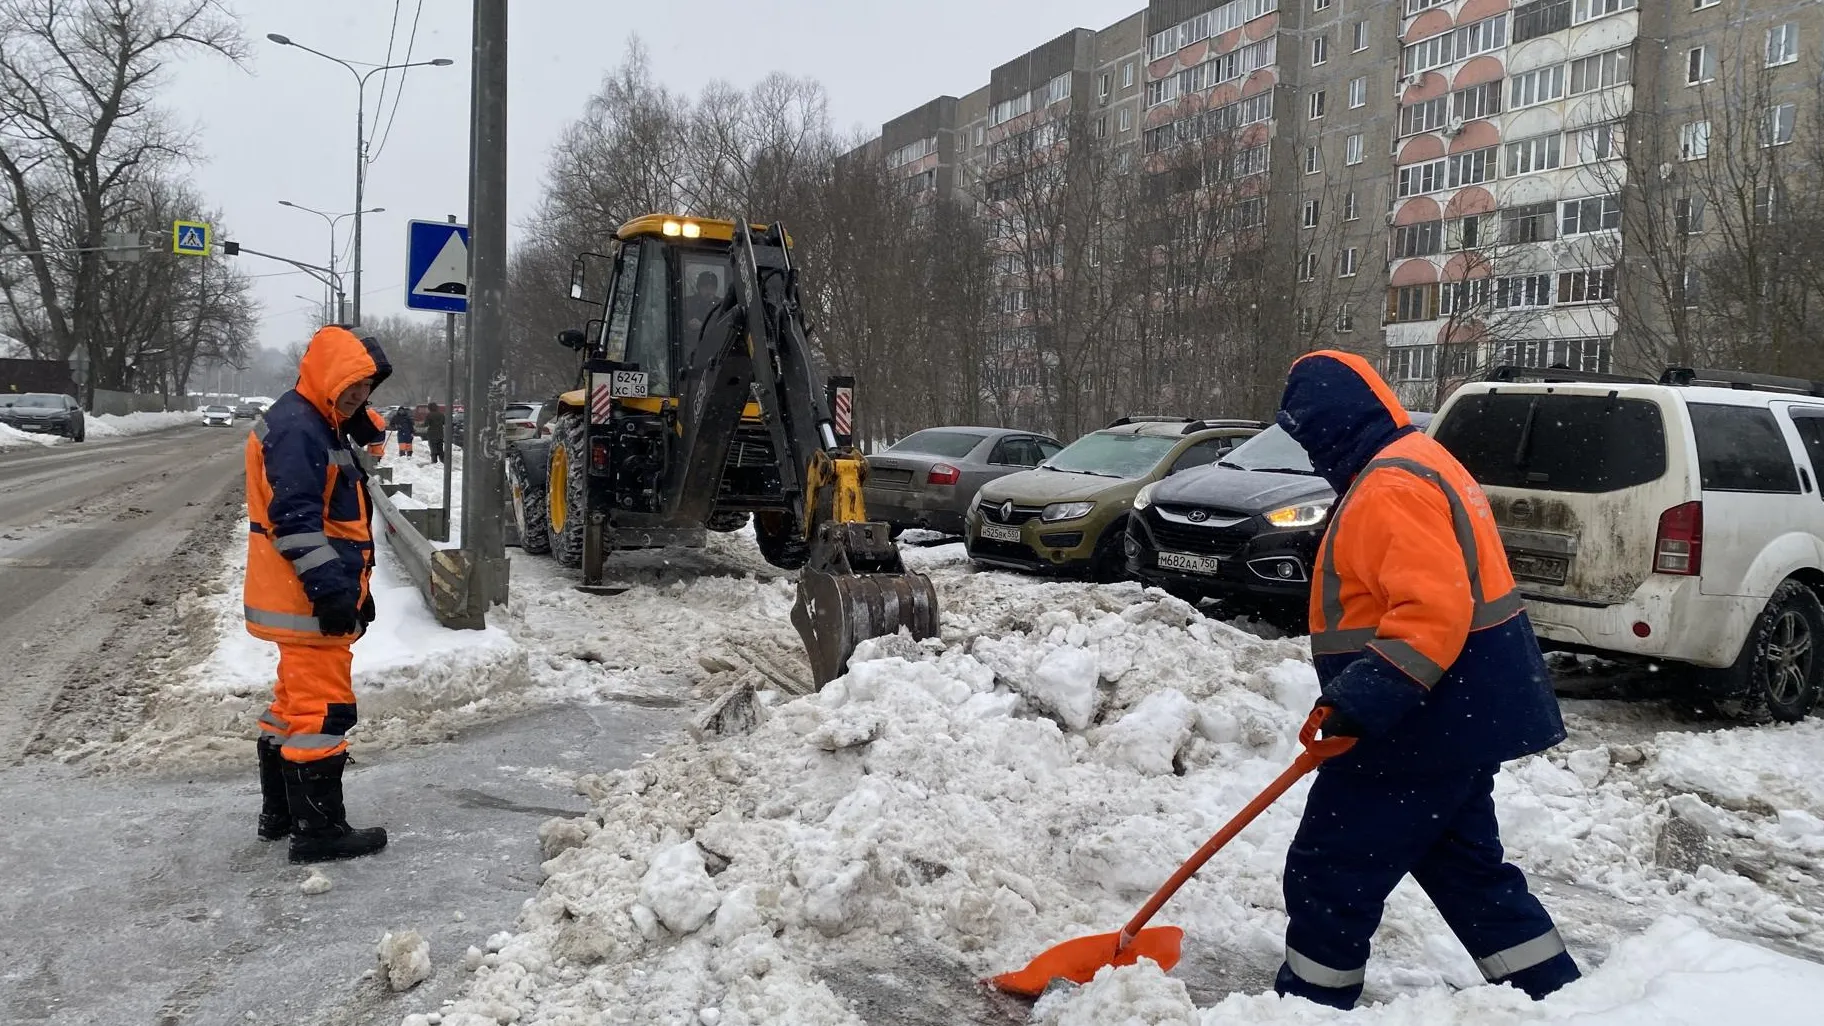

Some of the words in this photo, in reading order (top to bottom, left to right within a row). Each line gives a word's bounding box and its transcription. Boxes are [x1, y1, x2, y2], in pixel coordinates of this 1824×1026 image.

[617, 371, 644, 383] 6247
[634, 385, 646, 394] 50
[1160, 554, 1198, 570] М682АА
[1200, 557, 1215, 569] 750
